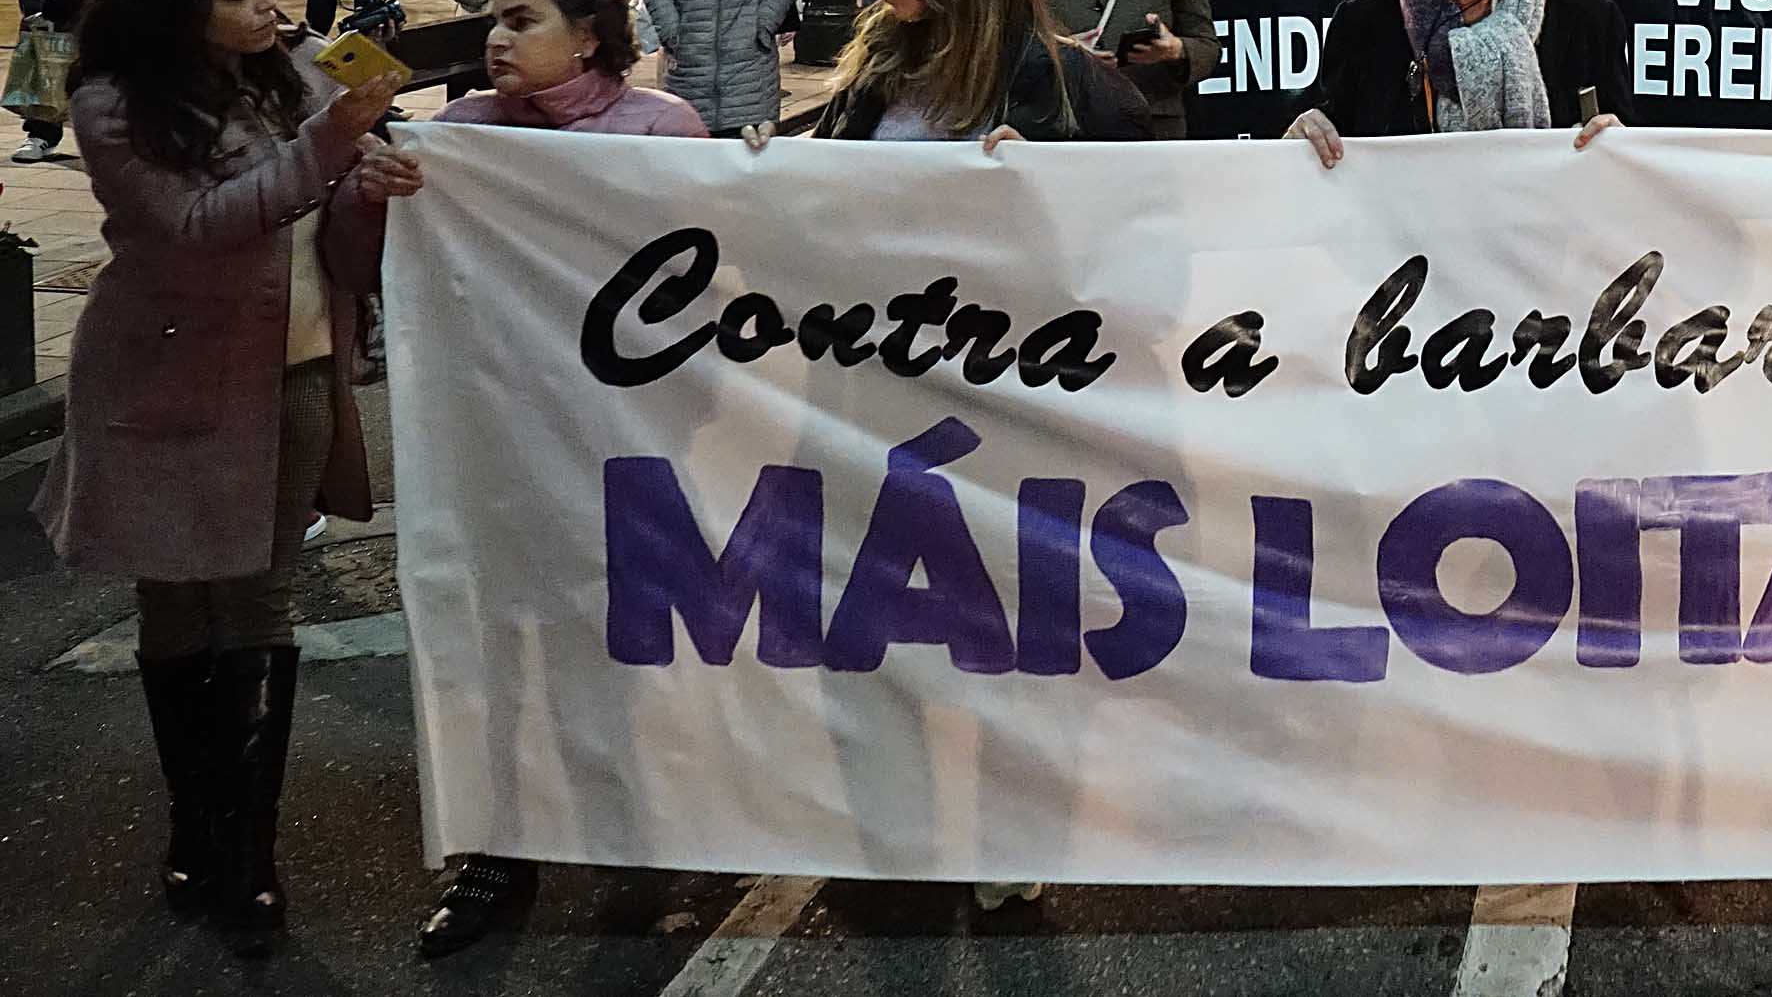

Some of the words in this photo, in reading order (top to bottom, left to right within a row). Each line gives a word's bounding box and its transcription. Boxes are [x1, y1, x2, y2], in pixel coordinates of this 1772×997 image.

[581, 226, 1117, 392] Contra
[1181, 310, 1280, 398] a
[603, 415, 1190, 681] MÁIS
